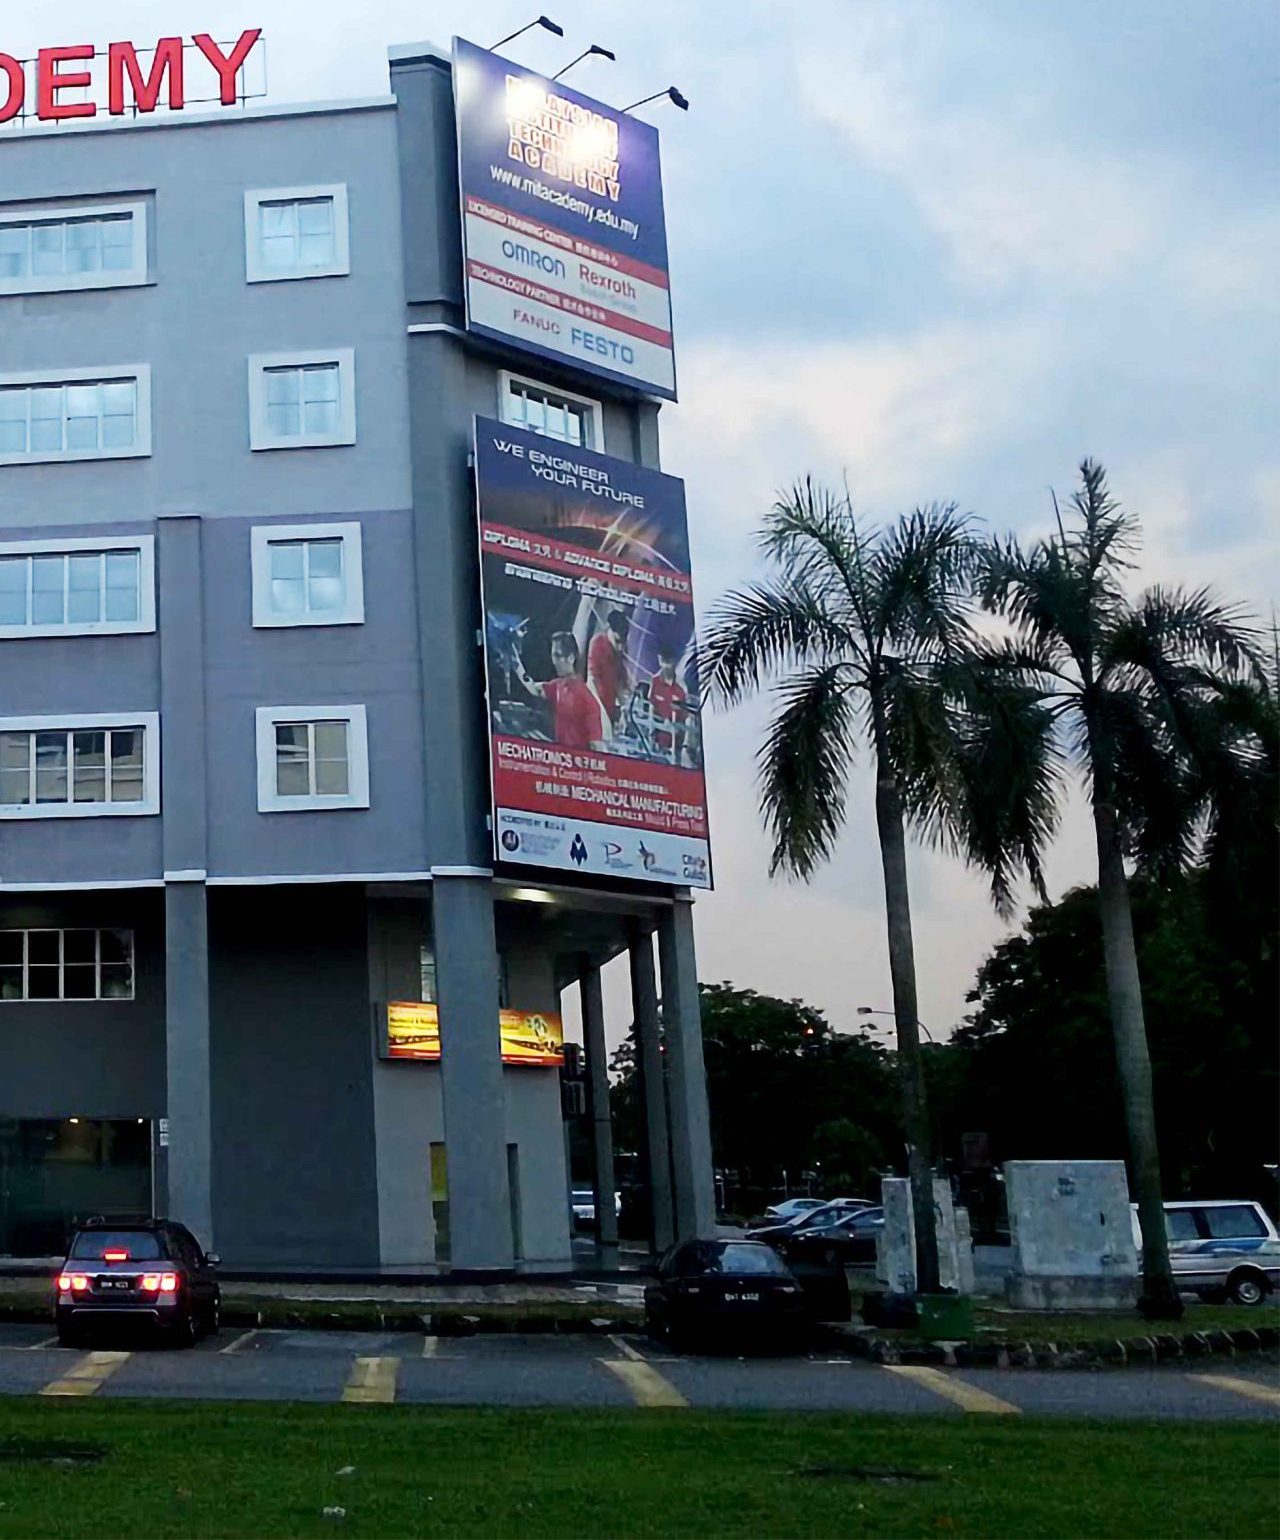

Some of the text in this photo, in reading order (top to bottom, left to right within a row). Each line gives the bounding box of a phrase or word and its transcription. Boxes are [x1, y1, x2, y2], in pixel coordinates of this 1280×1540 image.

[508, 138, 620, 202] ACADEMY
[490, 165, 639, 239] www.mitacademy.edu.my
[502, 240, 565, 279] OMRON
[579, 263, 636, 299] Rexroth
[513, 309, 561, 335] FANUC
[571, 327, 634, 365] FESTO
[493, 438, 609, 484] WE ENGINEER
[531, 464, 645, 509] YOUR FUTURE
[497, 741, 573, 768] MECHATRONICS
[630, 795, 704, 820] MANUFACTURING
